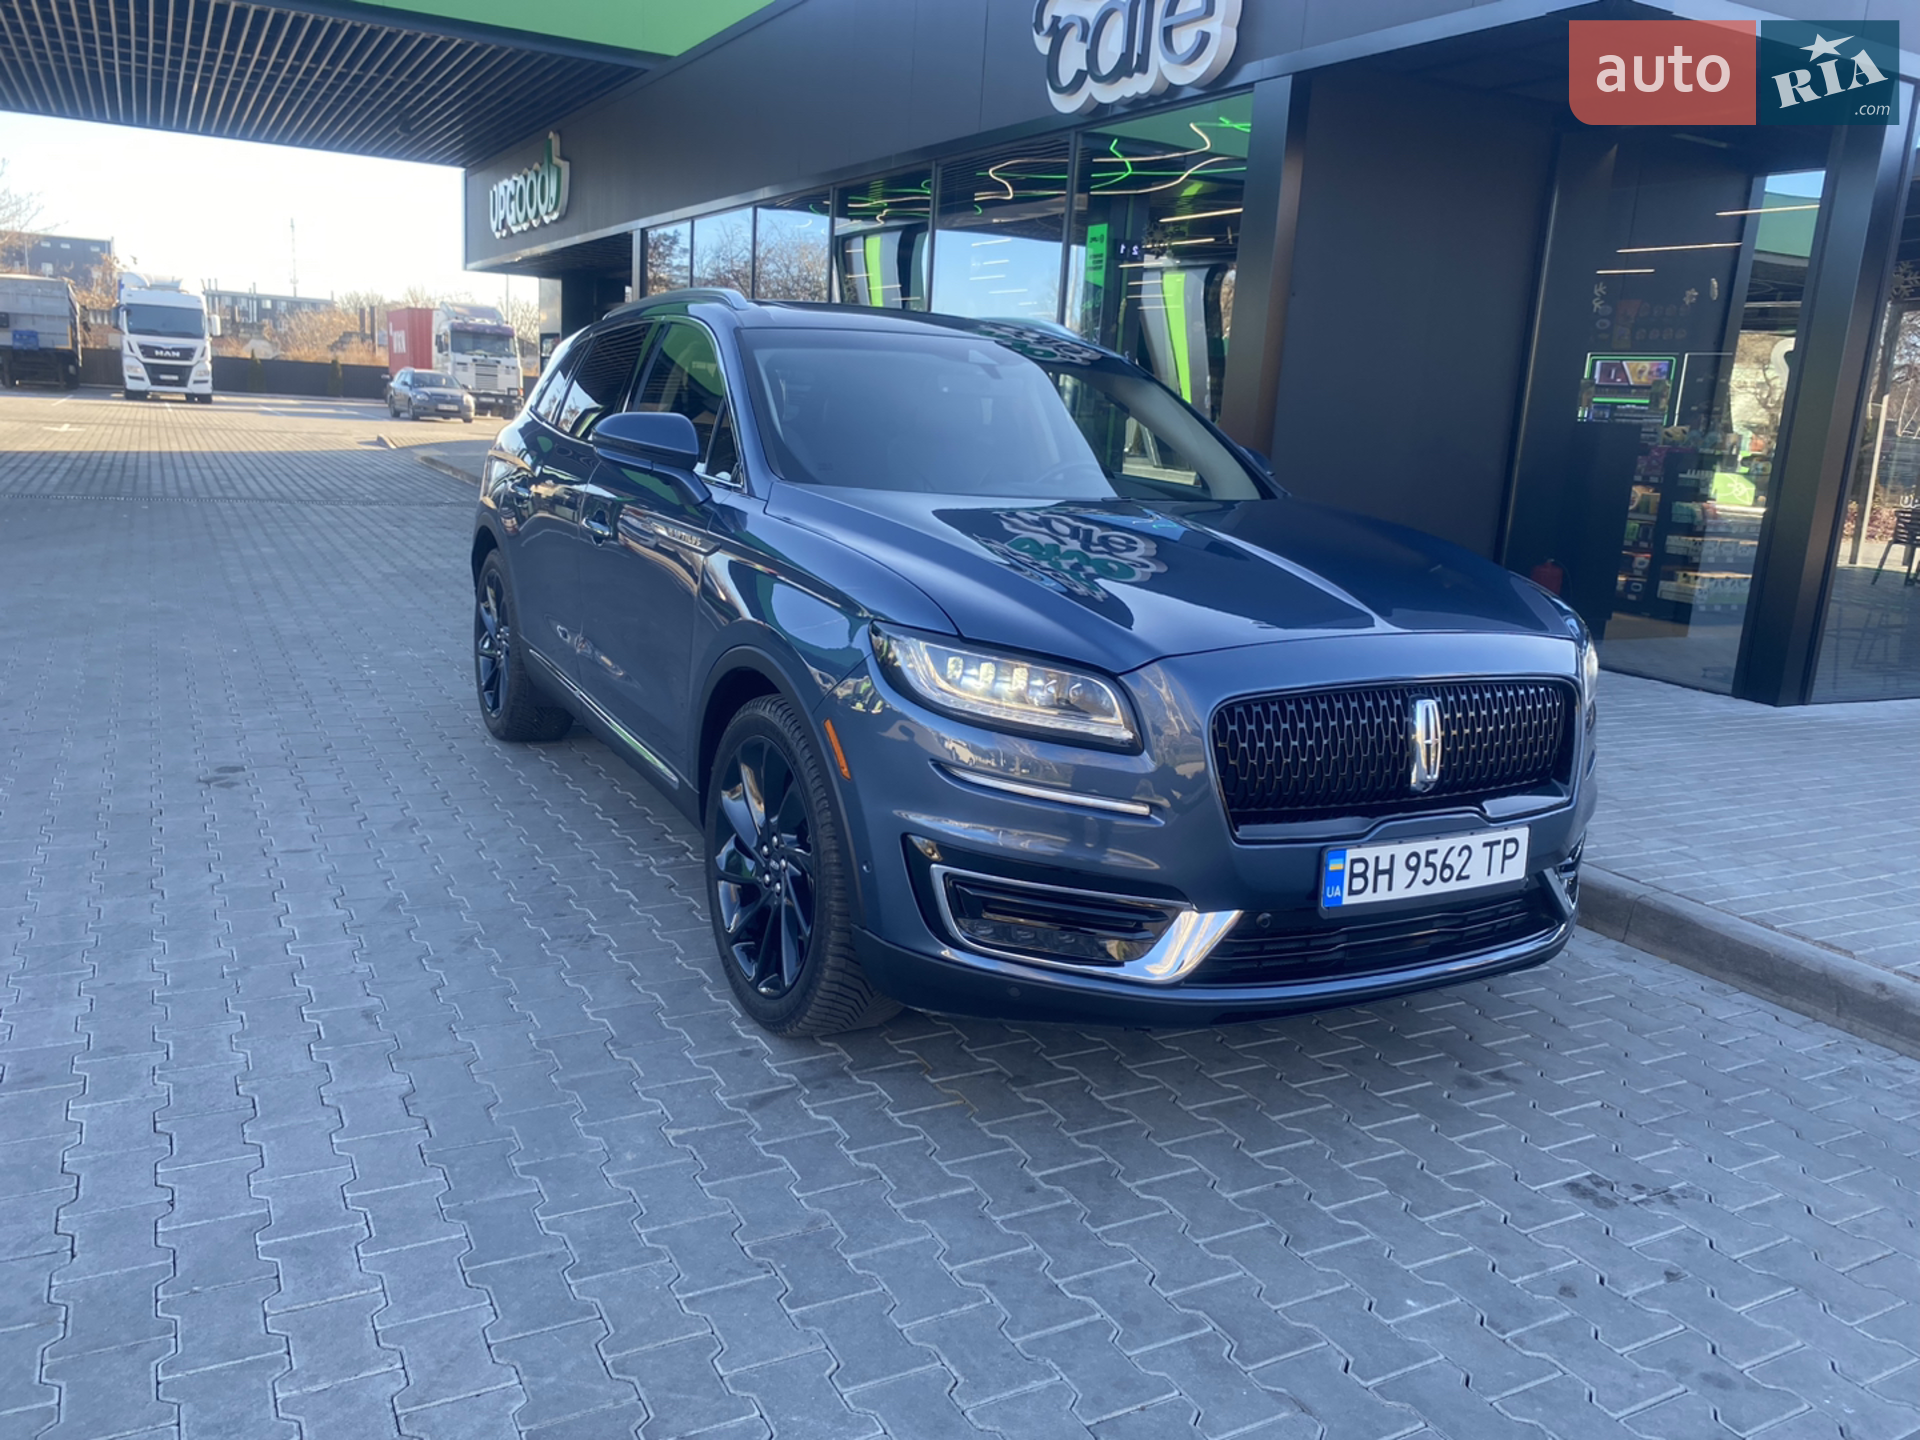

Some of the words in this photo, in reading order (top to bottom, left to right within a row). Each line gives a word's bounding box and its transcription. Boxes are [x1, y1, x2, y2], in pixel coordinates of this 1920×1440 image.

[154, 350, 180, 358] MAN
[1347, 853, 1396, 897] BH
[1404, 844, 1473, 889] 9562
[1482, 836, 1520, 877] TP
[1326, 885, 1341, 898] UA
